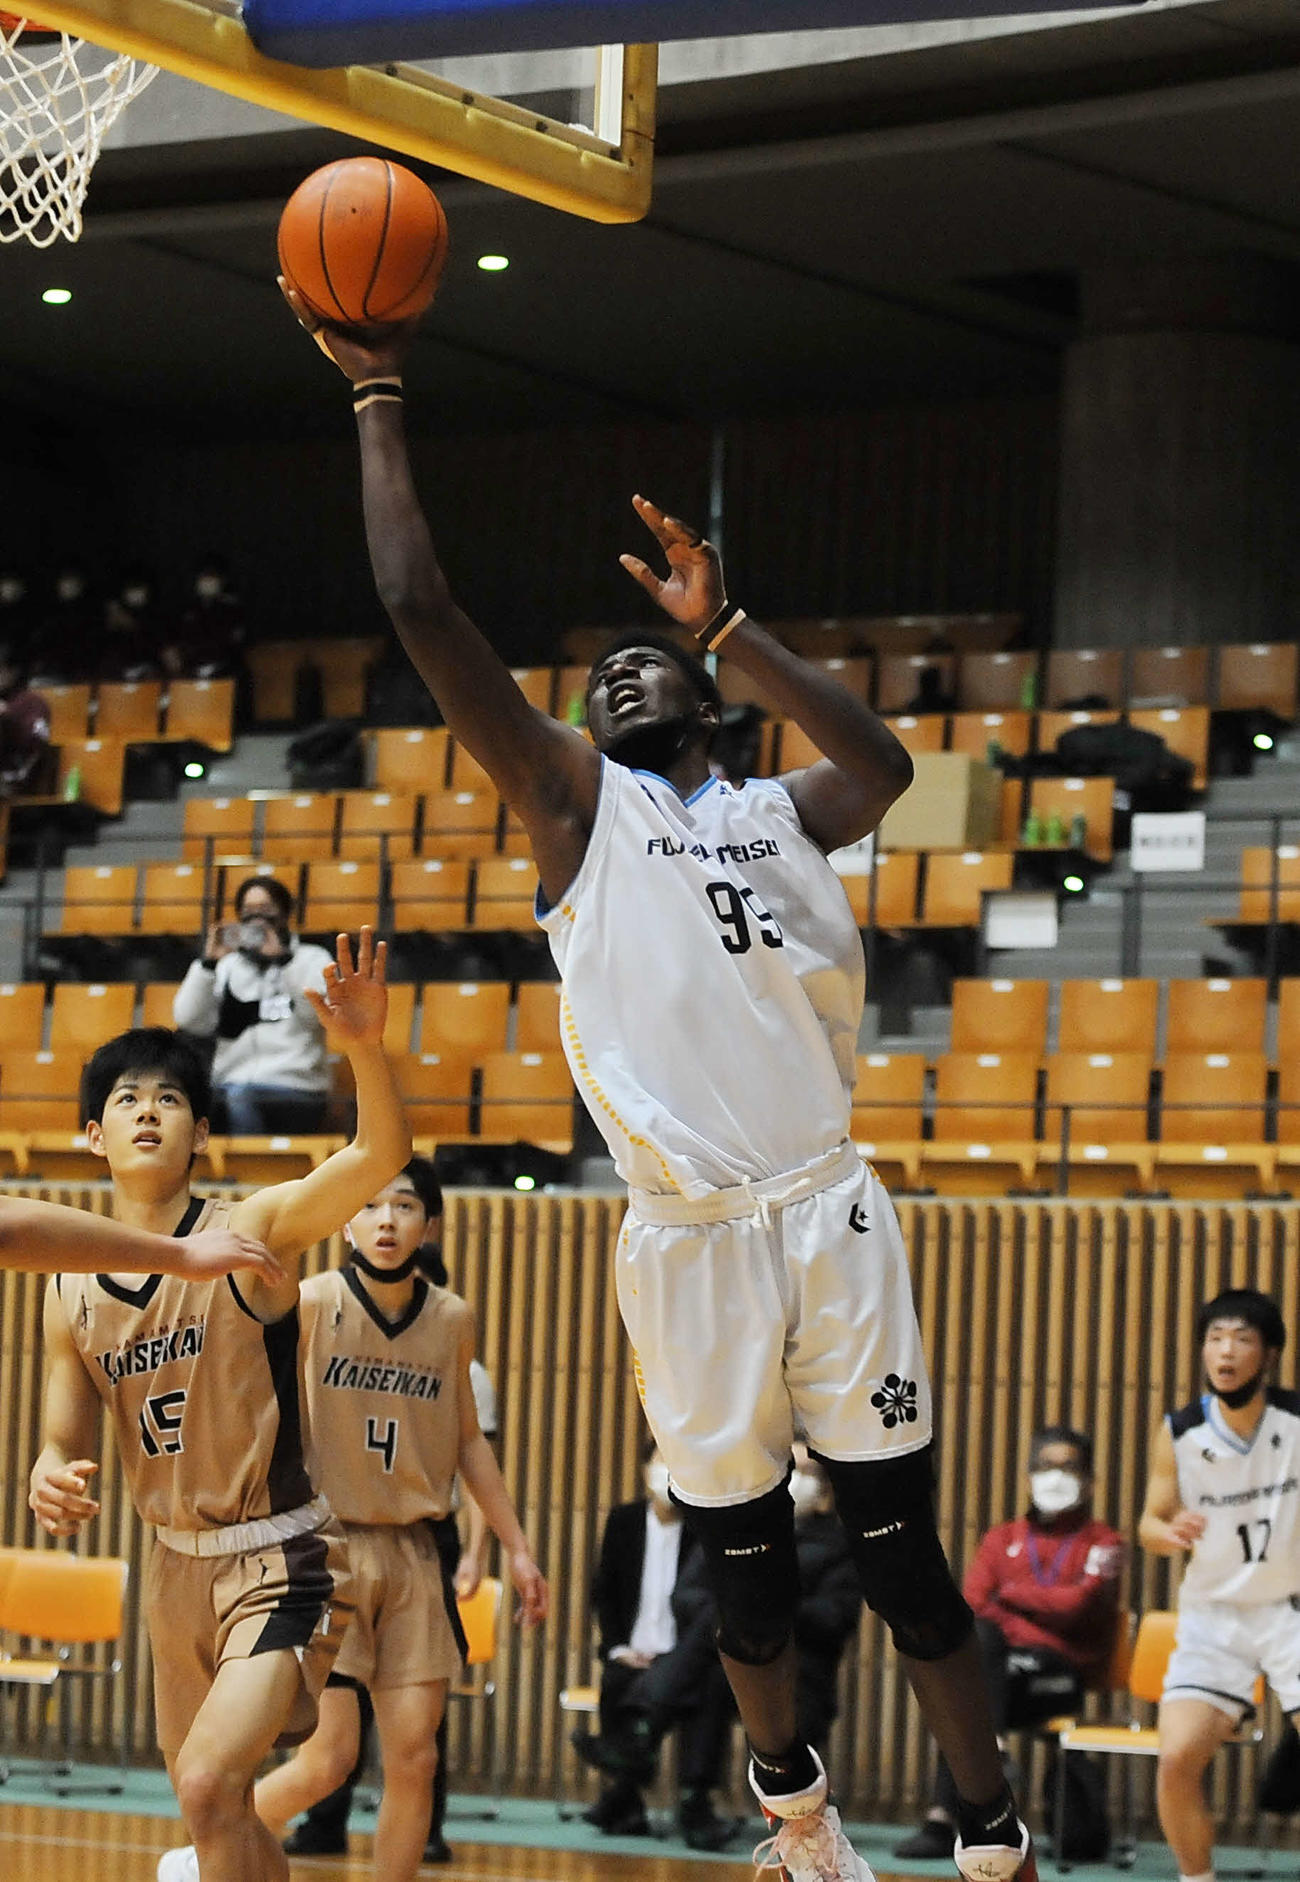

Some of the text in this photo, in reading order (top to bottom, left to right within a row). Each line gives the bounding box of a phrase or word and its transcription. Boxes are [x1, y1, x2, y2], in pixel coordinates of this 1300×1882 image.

[322, 1355, 443, 1401] KAISEIKAN
[139, 1389, 188, 1458] 15
[366, 1417, 399, 1474] 4
[1236, 1517, 1272, 1564] 17
